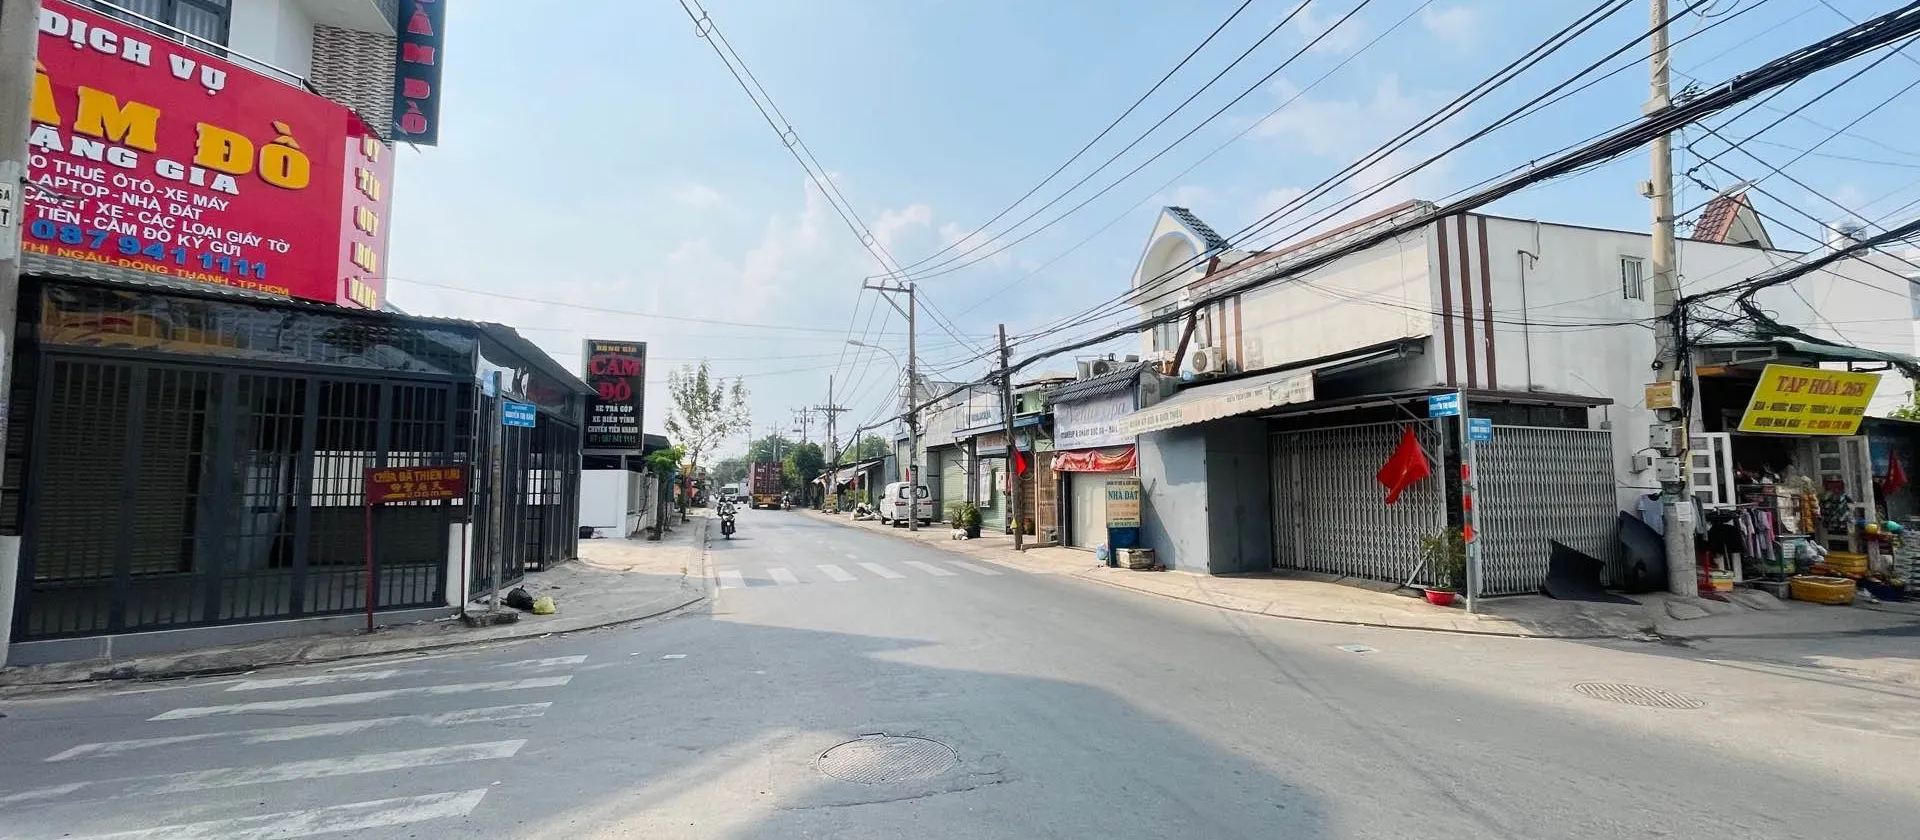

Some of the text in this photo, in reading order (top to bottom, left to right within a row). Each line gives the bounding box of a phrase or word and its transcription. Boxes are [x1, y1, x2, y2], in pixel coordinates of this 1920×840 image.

[38, 8, 227, 96] DỊCH VỤ
[194, 120, 310, 190] ĐỒ
[52, 159, 106, 183] THUÊ
[193, 194, 229, 212] MÁY
[156, 159, 240, 195] GIA
[169, 200, 204, 220] ĐẤT
[31, 218, 266, 280] 087 941 1111
[143, 227, 172, 243] ĐỒ
[177, 233, 204, 249] KÝ
[210, 239, 241, 257] GỬI
[182, 220, 222, 241] LOẠI
[226, 230, 263, 248] GIẤY
[267, 238, 291, 253] TỜ
[590, 352, 641, 376] CẦM
[598, 378, 631, 401] ĐỒ
[1775, 376, 1809, 396] TẠP
[1808, 375, 1839, 395] HÓA
[1108, 486, 1139, 500] NHÀ ĐẤT
